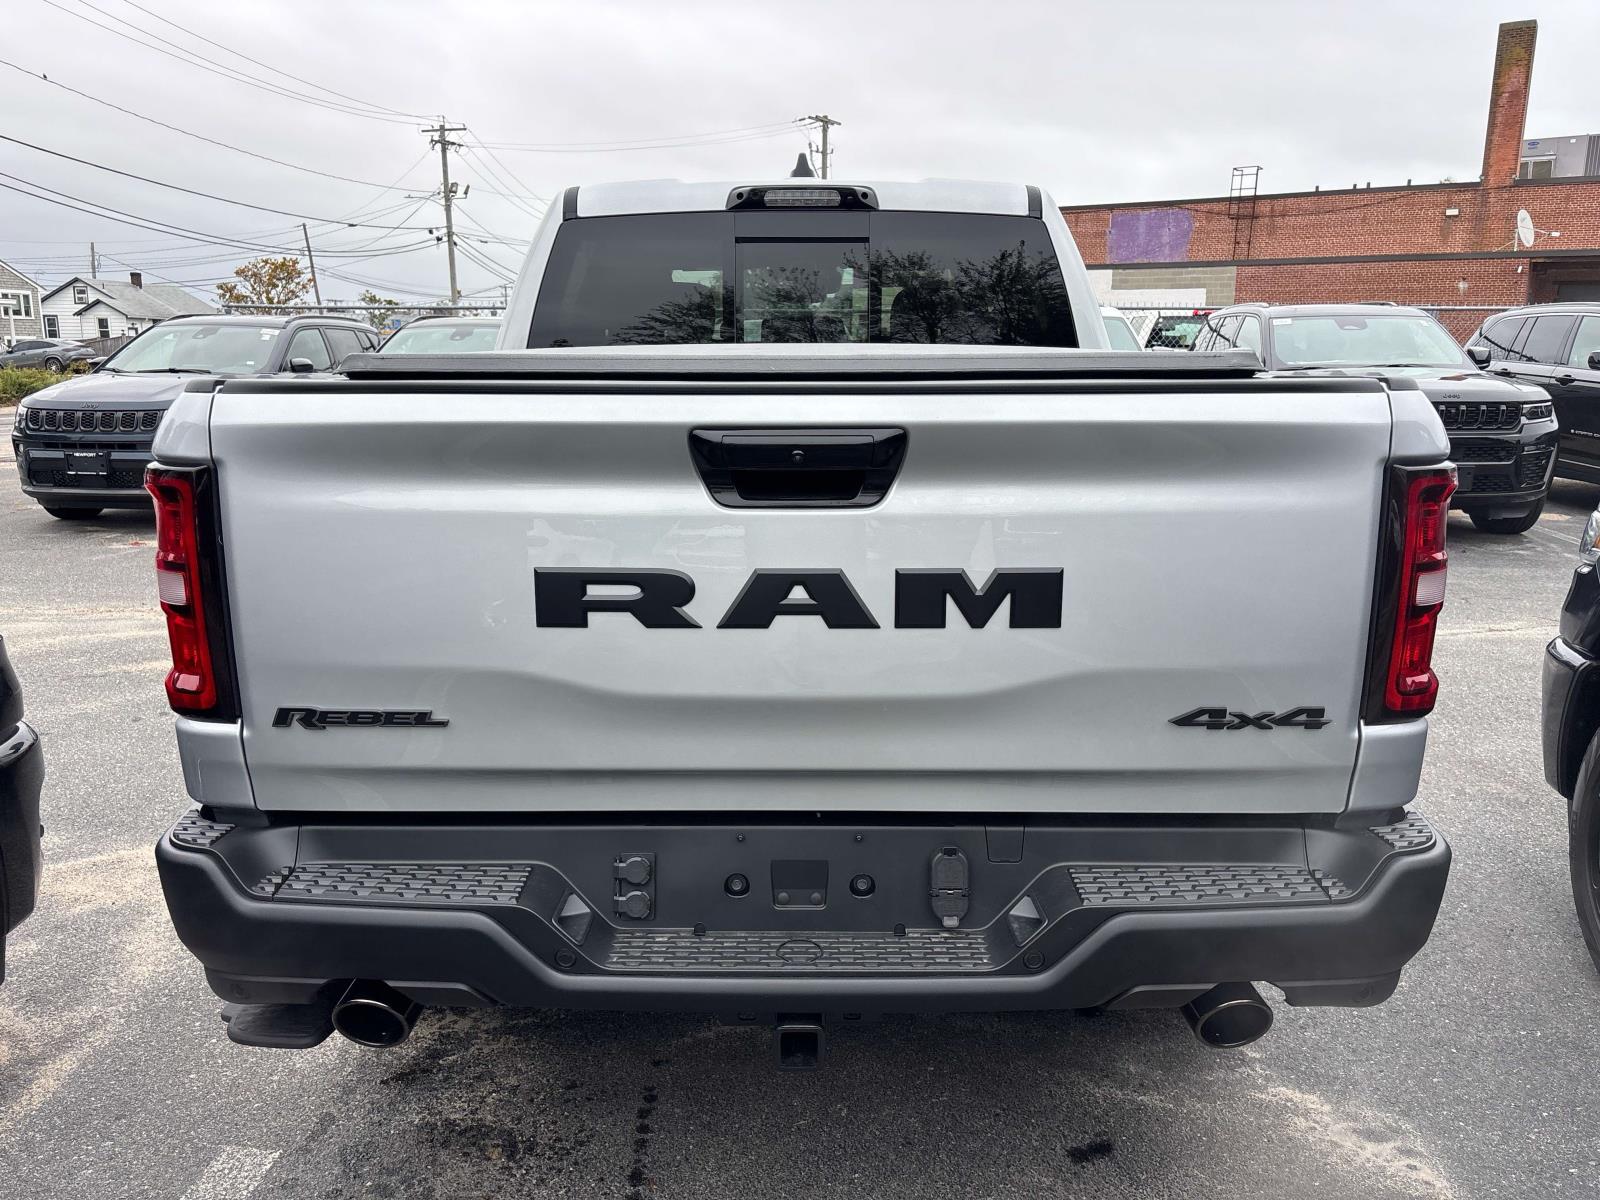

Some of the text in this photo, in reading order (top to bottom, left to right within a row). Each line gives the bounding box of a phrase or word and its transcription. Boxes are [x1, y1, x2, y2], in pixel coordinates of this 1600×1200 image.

[533, 567, 1064, 629] RAM
[272, 707, 449, 730] REBEL
[1168, 706, 1333, 729] 4x4
